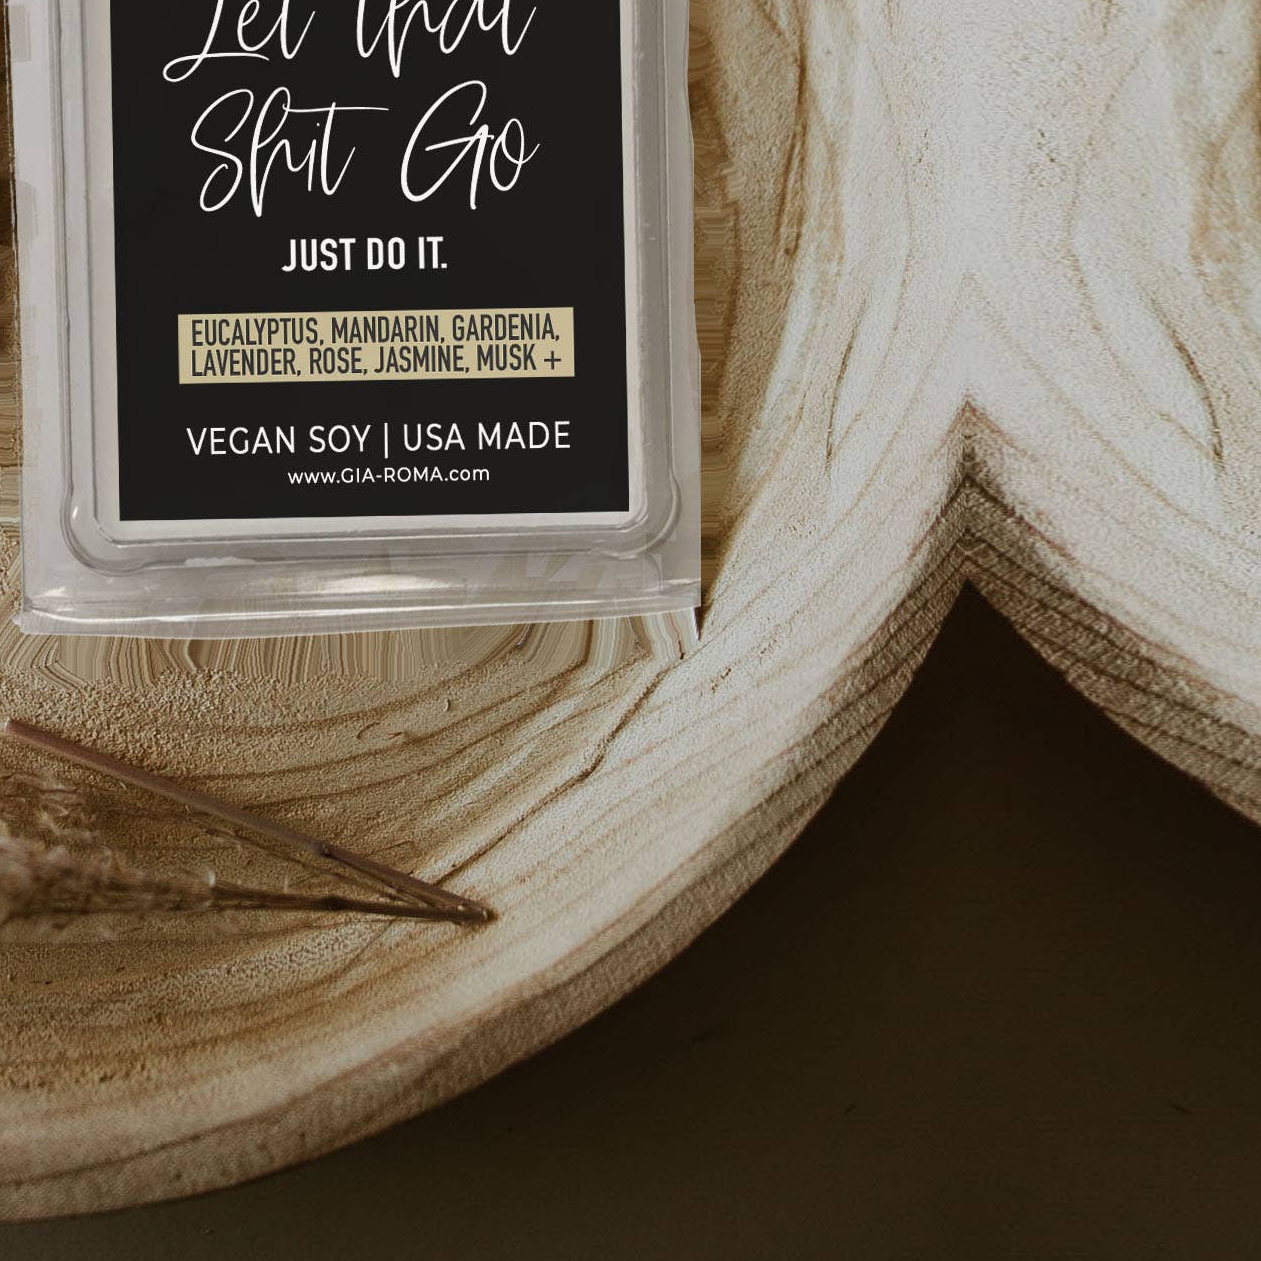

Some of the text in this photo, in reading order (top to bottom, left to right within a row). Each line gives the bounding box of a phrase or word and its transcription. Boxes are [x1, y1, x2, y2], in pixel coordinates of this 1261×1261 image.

[190, 79, 541, 218] Shit Go
[281, 236, 448, 272] JUST DO IT.
[191, 312, 560, 347] EUCALYPTUS, MANDARIN, GARDENIA,
[191, 343, 562, 377] LAVENDER, ROSE, JASMINE, MUSK +
[186, 425, 295, 456] VEGAN
[309, 424, 372, 453] SOY
[403, 422, 466, 452] USA
[478, 420, 571, 450] MADE
[287, 466, 490, 485] www.GIA-ROMA.com
